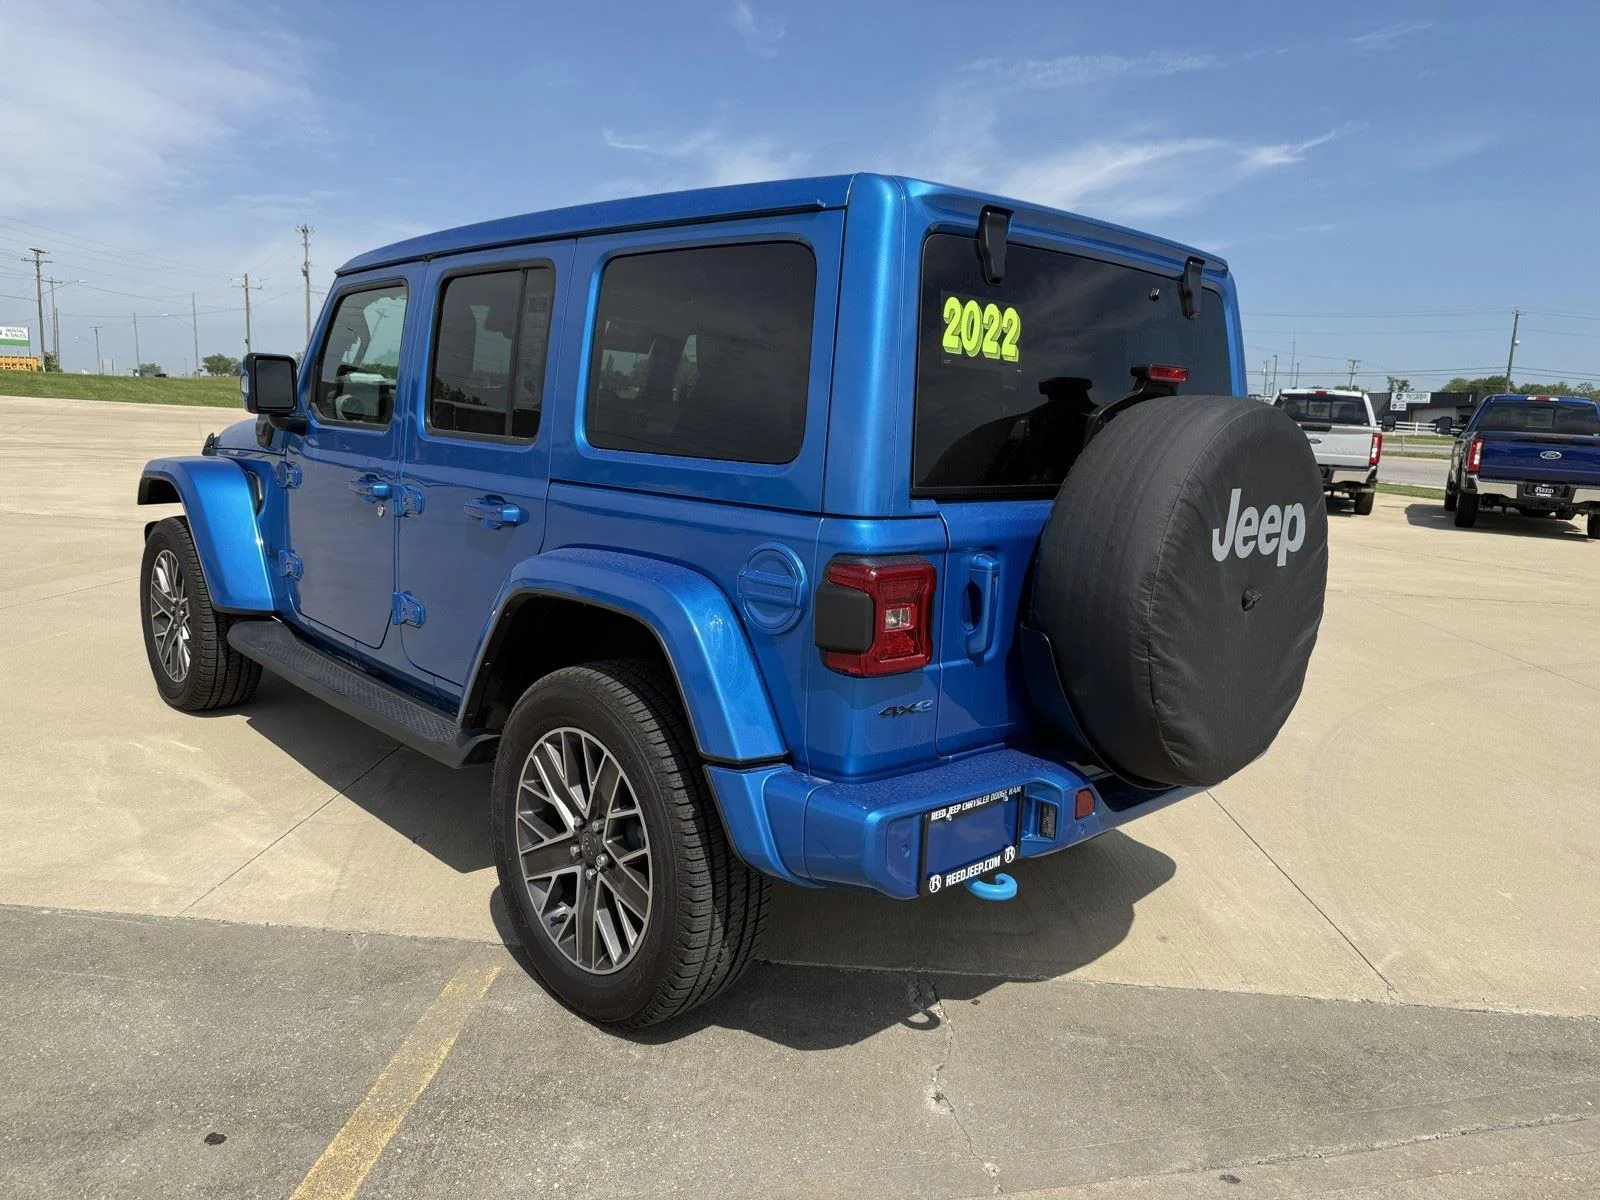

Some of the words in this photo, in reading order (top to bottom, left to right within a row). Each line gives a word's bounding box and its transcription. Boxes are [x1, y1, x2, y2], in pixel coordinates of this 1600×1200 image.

[943, 296, 1021, 363] 2022
[1212, 487, 1306, 567] Jeep
[931, 808, 947, 821] REED
[948, 804, 961, 816] JEEP
[962, 794, 990, 811] CHRYSLER
[990, 788, 1008, 802] DODGE
[945, 855, 1001, 888] REEDJEEP.COM
